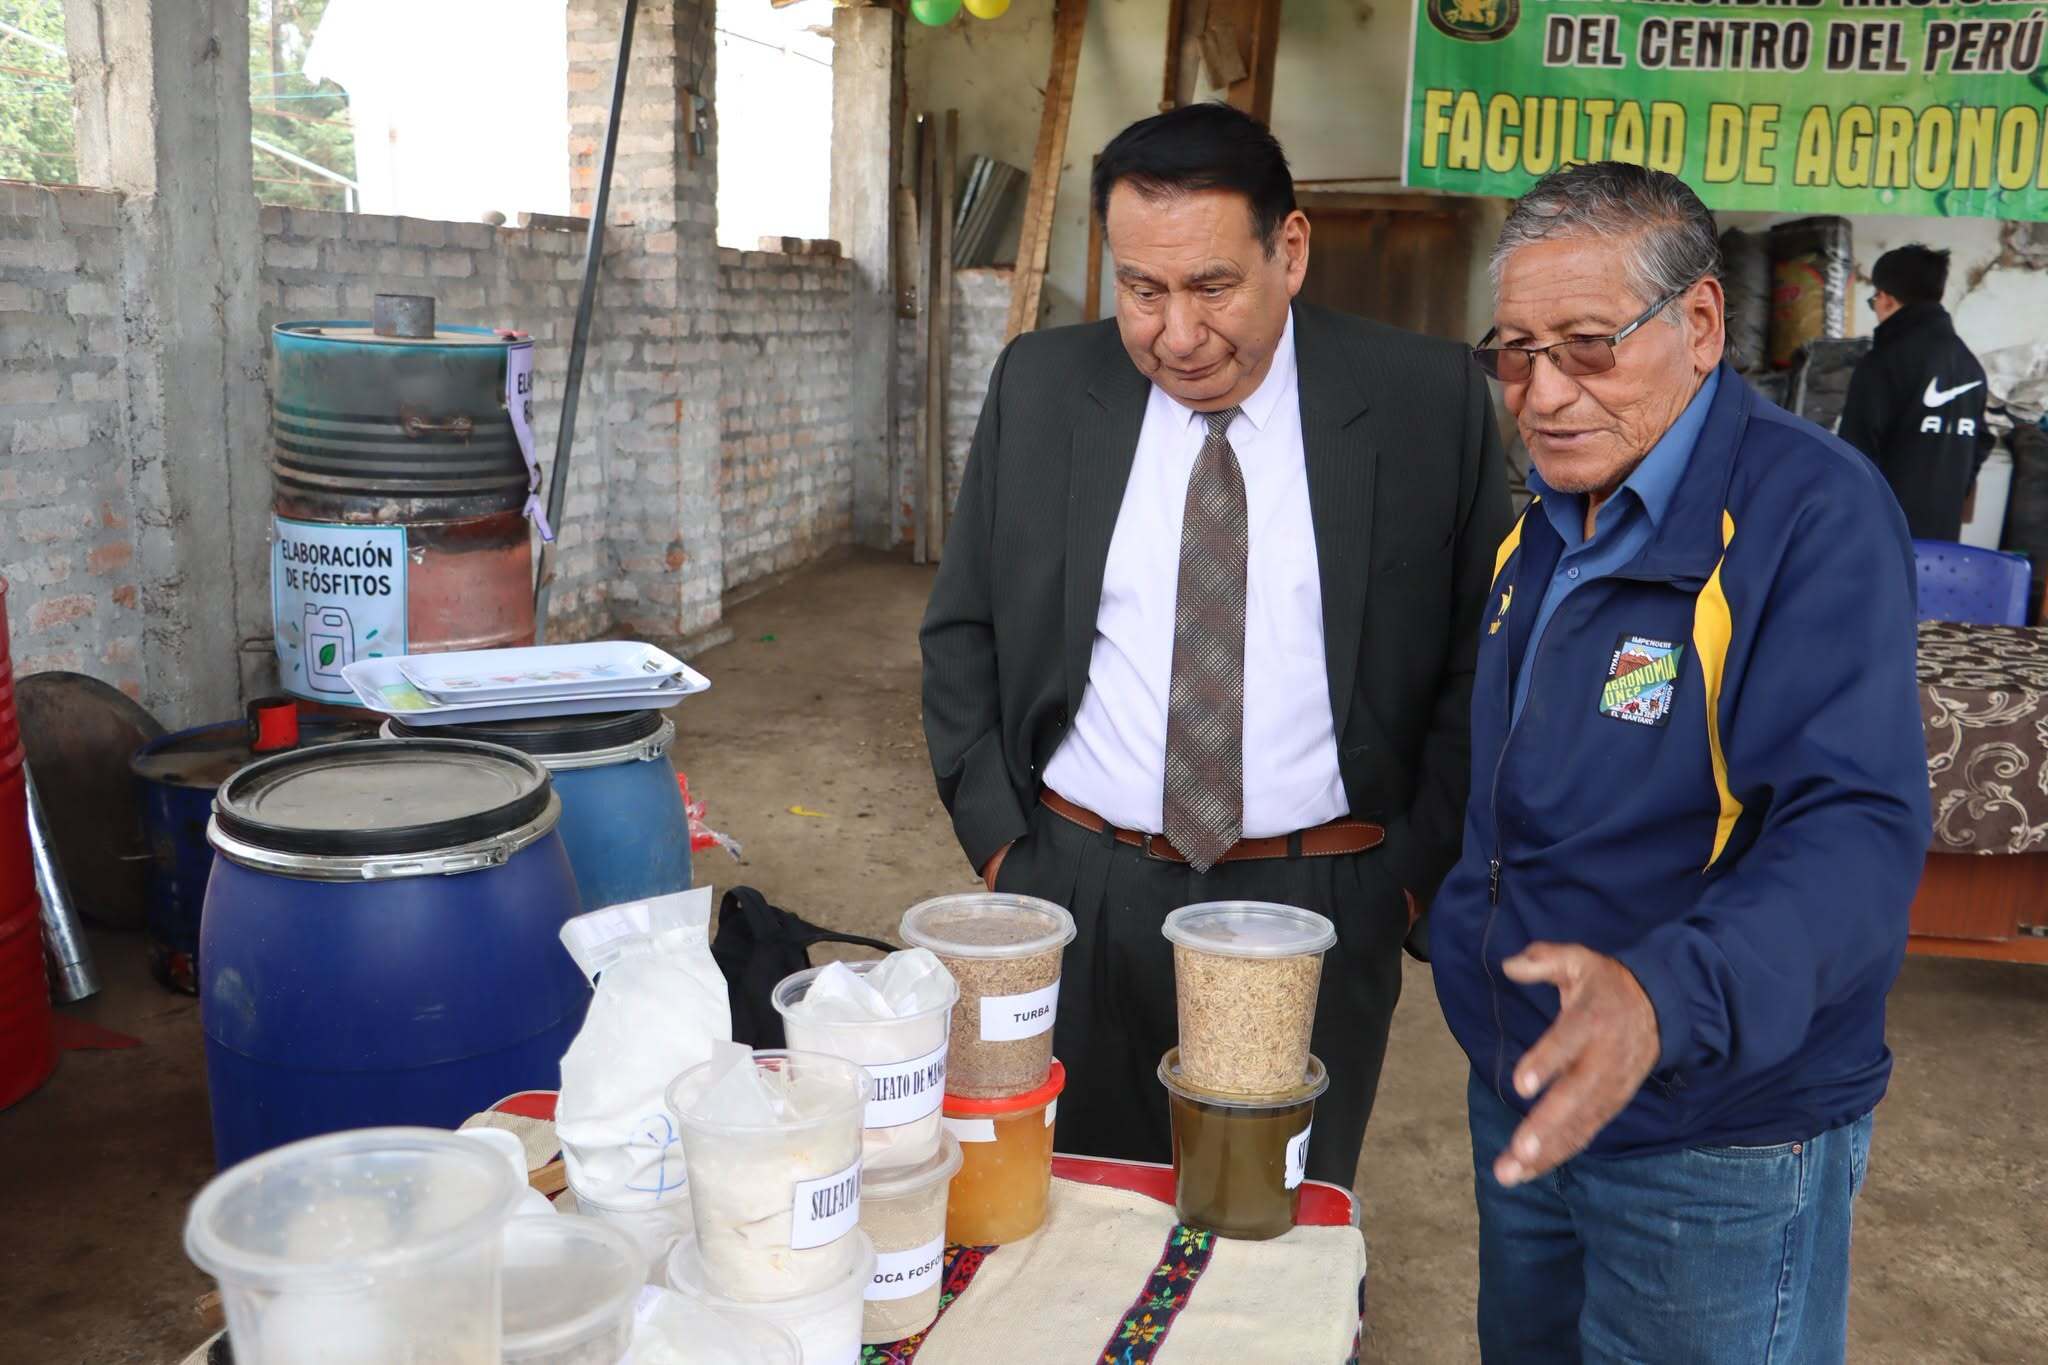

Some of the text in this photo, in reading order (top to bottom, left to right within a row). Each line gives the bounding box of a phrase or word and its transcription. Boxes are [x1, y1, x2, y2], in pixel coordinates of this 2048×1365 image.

[1545, 11, 2046, 72] DEL CENTRO DEL PERÚ
[1421, 88, 2048, 191] FACULTAD DE AGRONO
[1920, 415, 1976, 437] AIR
[281, 539, 393, 568] ELABORACIÓN
[286, 566, 391, 596] DE FÓSFITOS
[1604, 653, 1677, 693] AGRONOMIA
[1608, 650, 1622, 676] VITAM
[1605, 686, 1641, 707] UNCP
[1013, 1004, 1050, 1024] TURBA
[912, 1068, 926, 1095] DE
[810, 1174, 856, 1222] SULFATO
[872, 1272, 904, 1284] OCA
